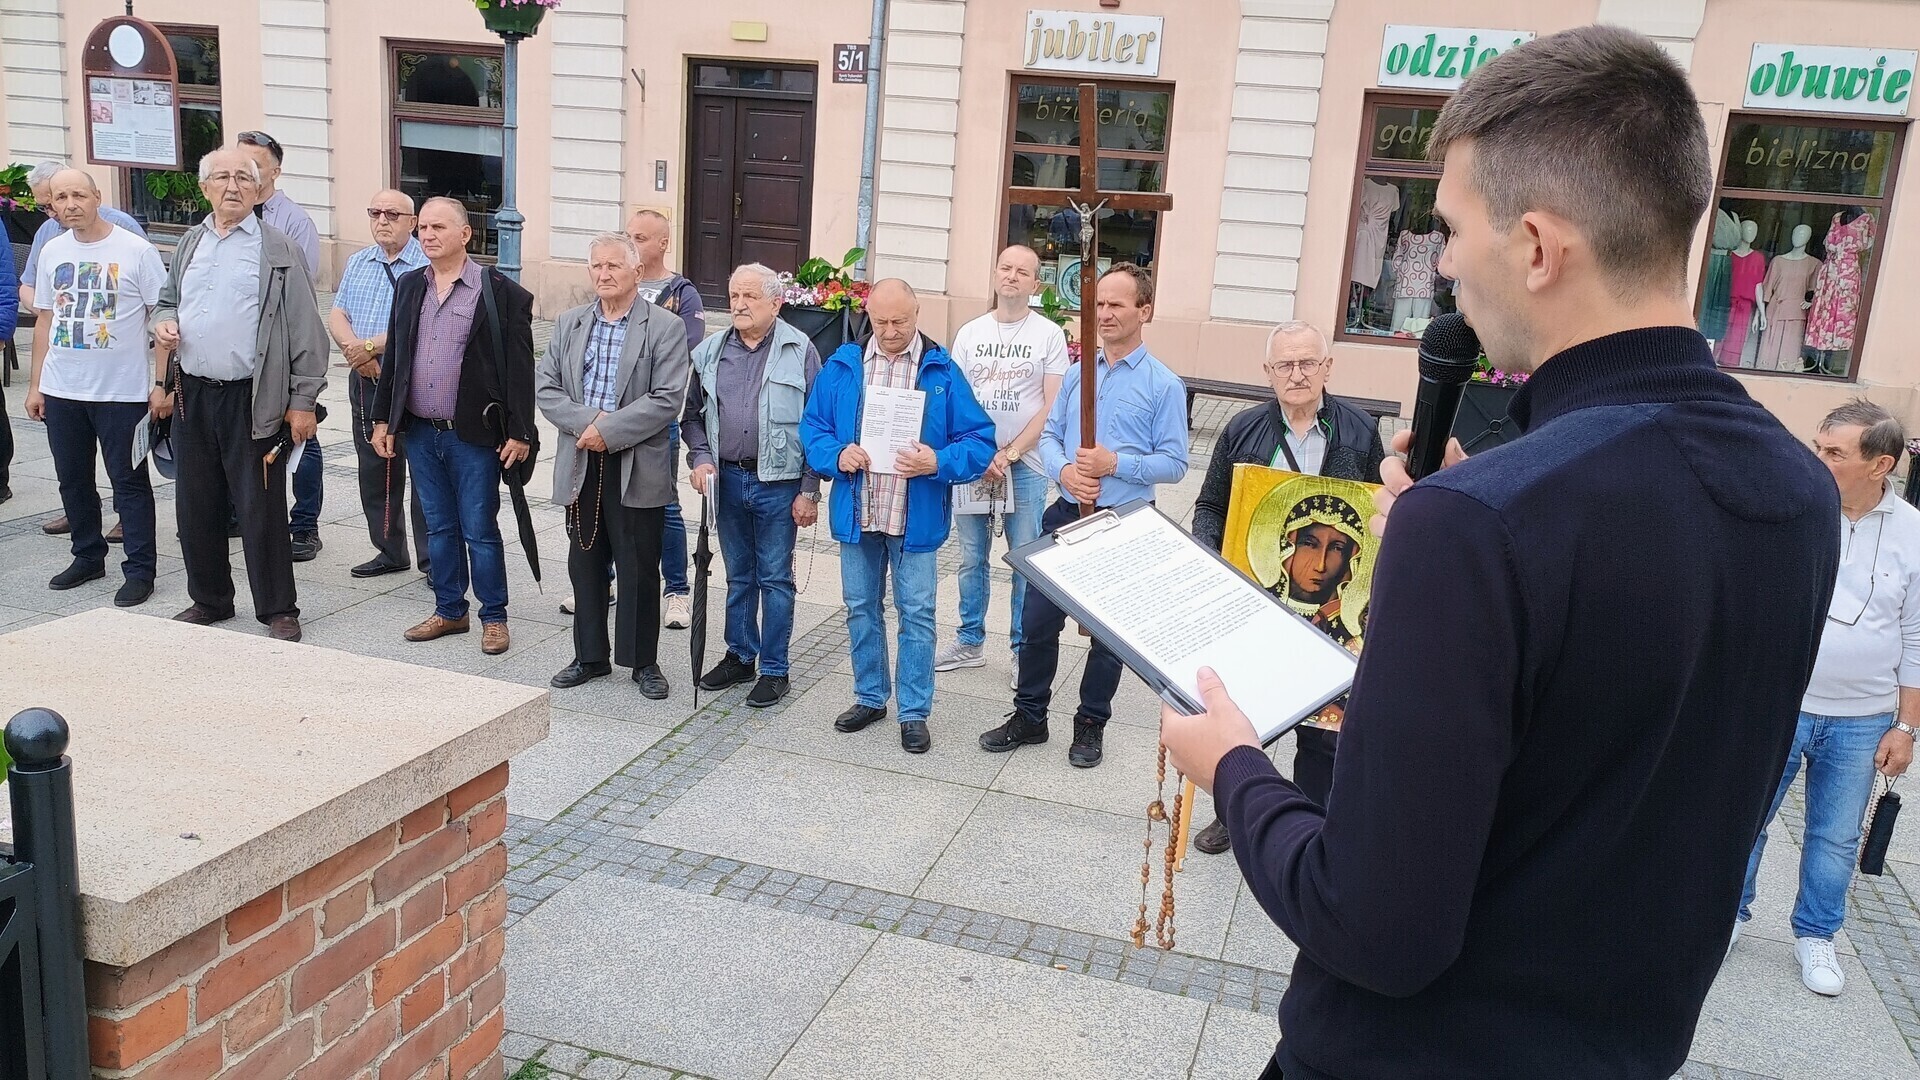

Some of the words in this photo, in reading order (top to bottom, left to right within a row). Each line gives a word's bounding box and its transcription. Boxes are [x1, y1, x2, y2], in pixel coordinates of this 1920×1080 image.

[1027, 17, 1157, 66] jubiler
[838, 50, 864, 71] 5/1
[1386, 33, 1521, 80] odzi
[1750, 51, 1912, 103] obuwie
[1035, 95, 1148, 127] biżeria
[1745, 137, 1871, 171] bielizna
[53, 262, 119, 291] ORI
[55, 291, 117, 319] GIN
[53, 320, 90, 350] AL
[975, 343, 1032, 358] SAILING
[978, 400, 998, 411] ALS
[1001, 402, 1021, 412] BAY
[993, 389, 1021, 400] CREW
